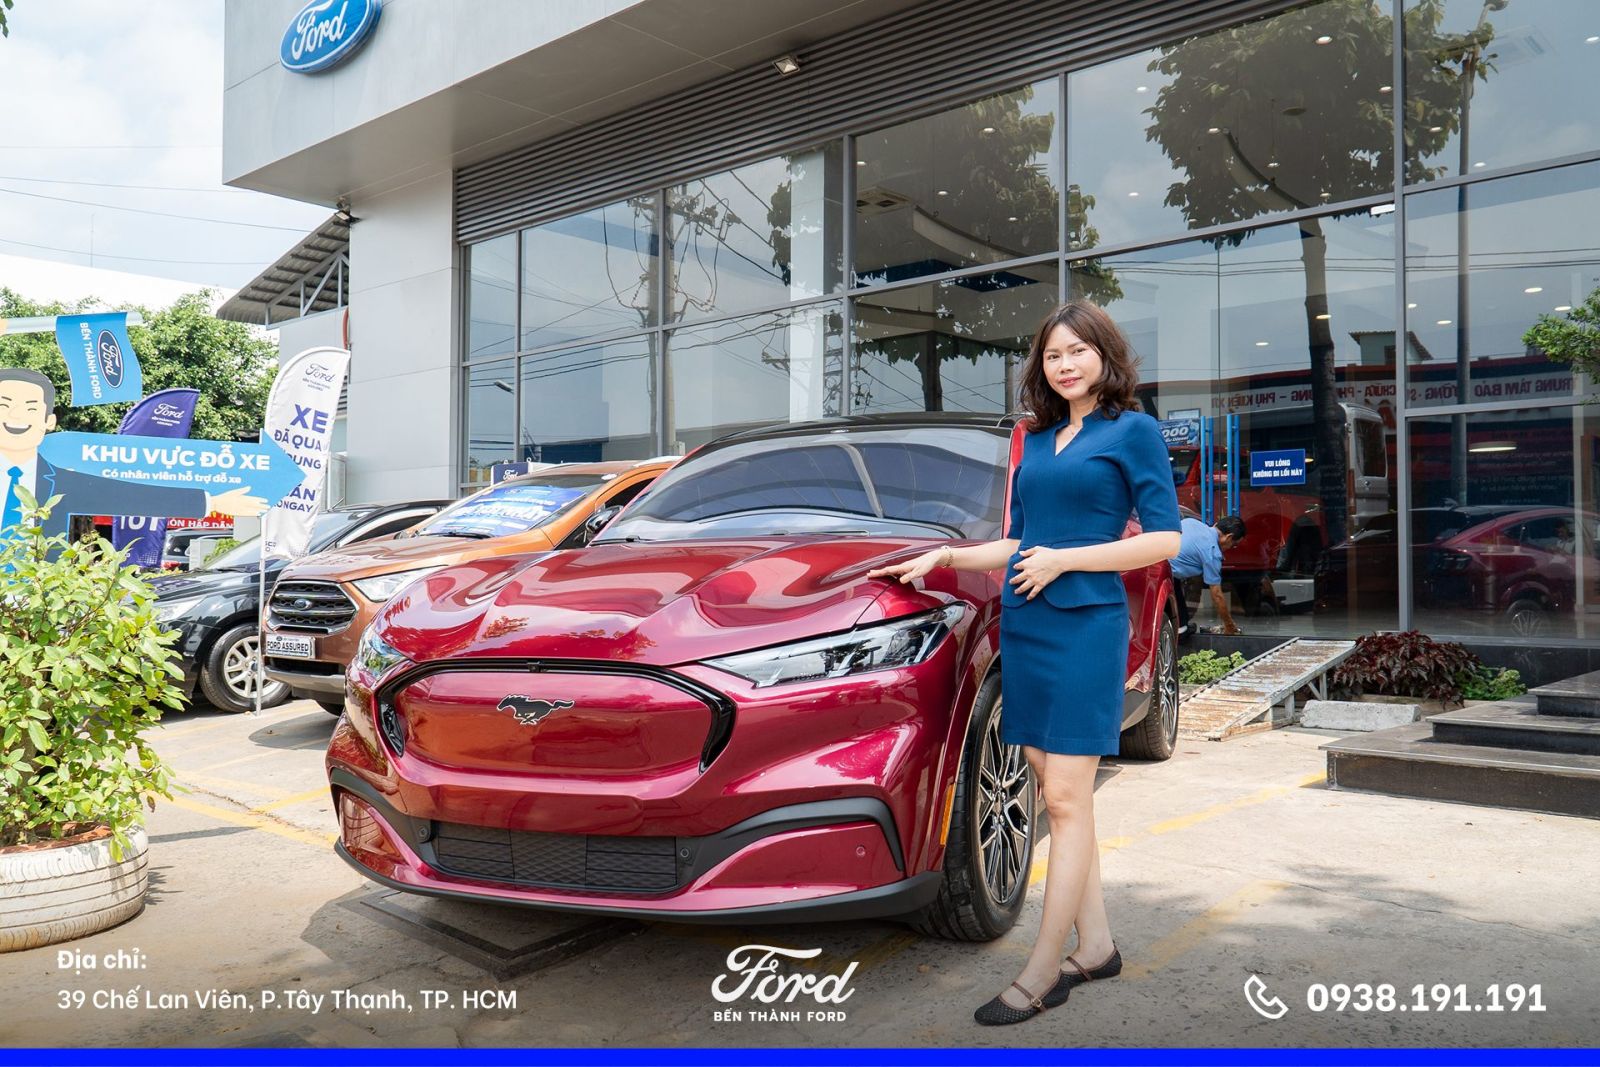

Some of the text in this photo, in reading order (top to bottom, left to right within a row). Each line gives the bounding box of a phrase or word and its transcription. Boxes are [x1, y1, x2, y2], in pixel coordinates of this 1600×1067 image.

[292, 0, 349, 60] Ford
[101, 342, 120, 376] Ford
[306, 363, 336, 382] Ford
[90, 375, 102, 399] FORD
[154, 403, 185, 418] Ford
[290, 404, 329, 434] XE
[274, 428, 322, 452] ĐÃ QUA
[82, 443, 271, 471] KHU VỰC ĐỖ XE
[1264, 460, 1275, 468] VUI
[102, 468, 119, 478] Có
[120, 469, 150, 480] nhân
[152, 470, 176, 481] viên
[228, 476, 242, 484] xe
[286, 483, 316, 501] ÁN
[267, 640, 309, 652] FORD ASSURED
